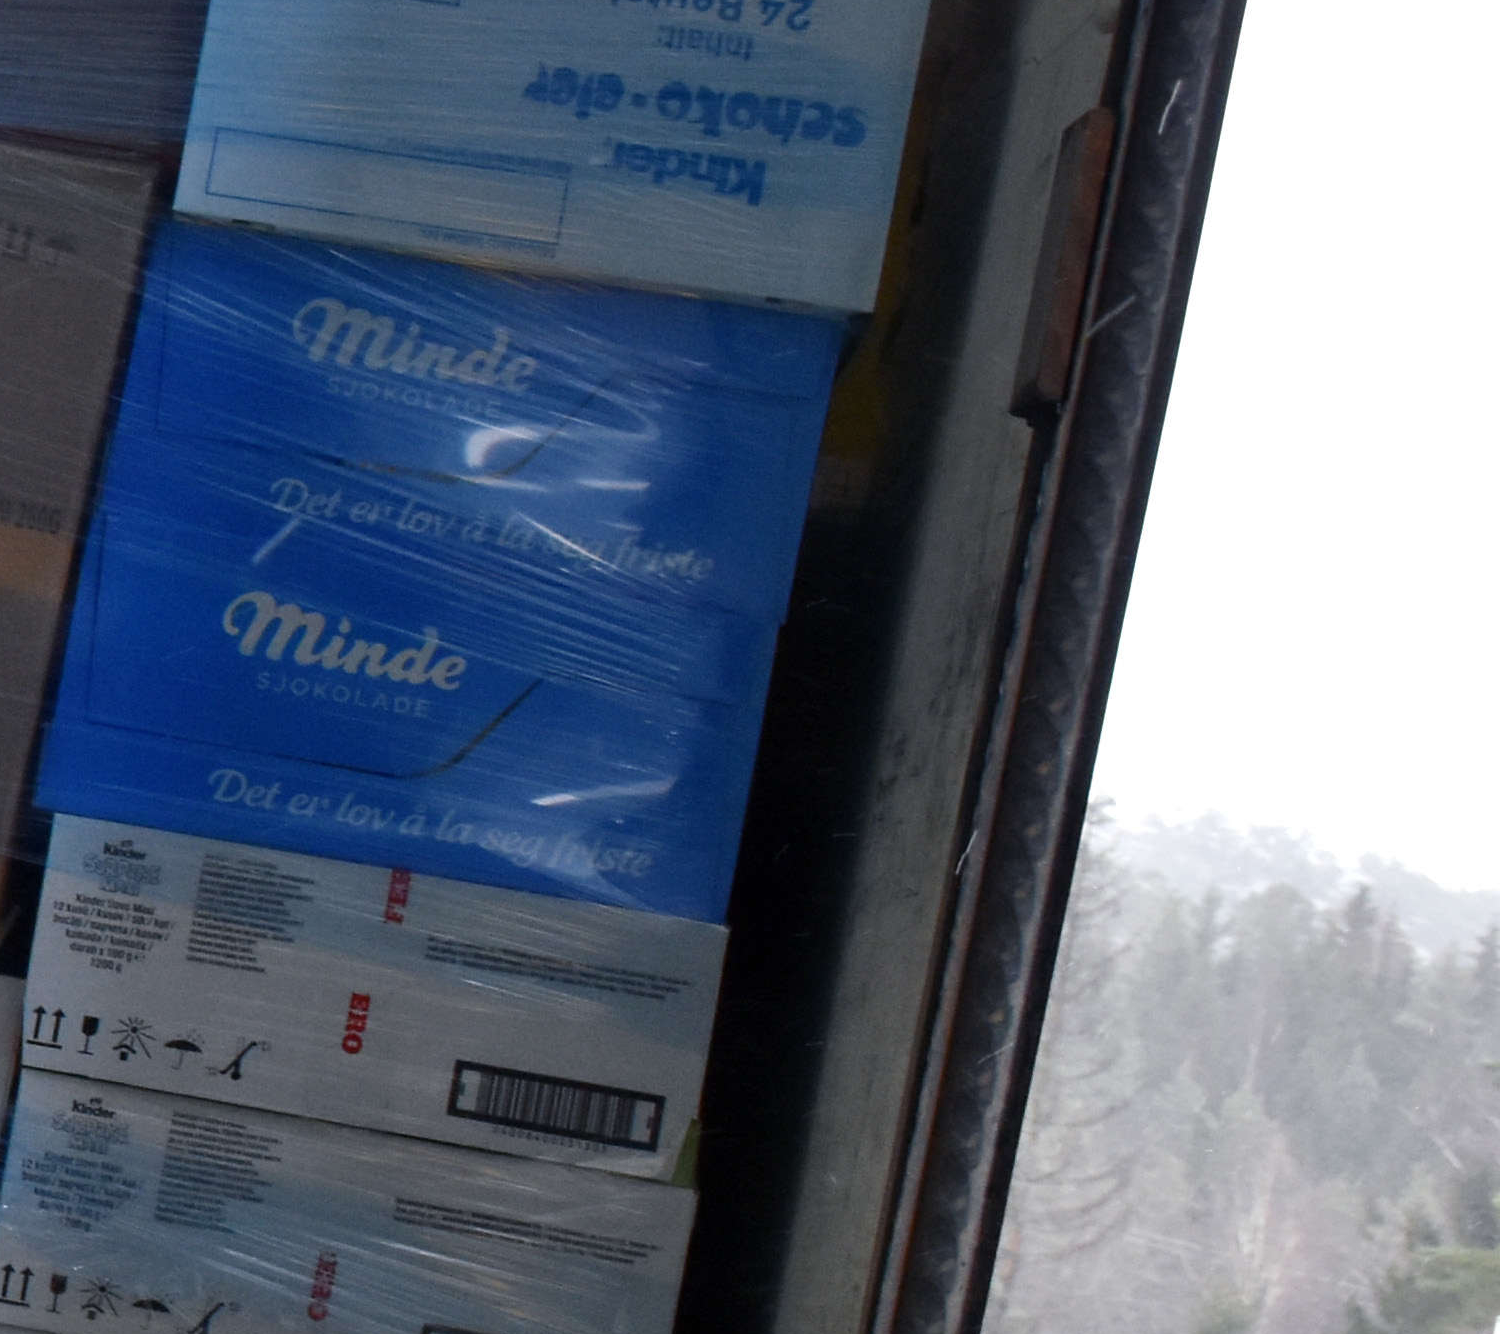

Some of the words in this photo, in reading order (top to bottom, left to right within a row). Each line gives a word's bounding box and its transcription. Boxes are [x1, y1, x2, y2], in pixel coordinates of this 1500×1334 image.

[292, 296, 538, 394] Minde
[270, 477, 342, 518] Det
[350, 499, 392, 525] er
[396, 497, 448, 535] lov
[222, 589, 469, 691] Minde
[255, 670, 433, 718] SJOKOLADE
[208, 767, 282, 810] Det
[287, 790, 331, 817] er
[334, 791, 395, 831] lov
[435, 808, 474, 845] la
